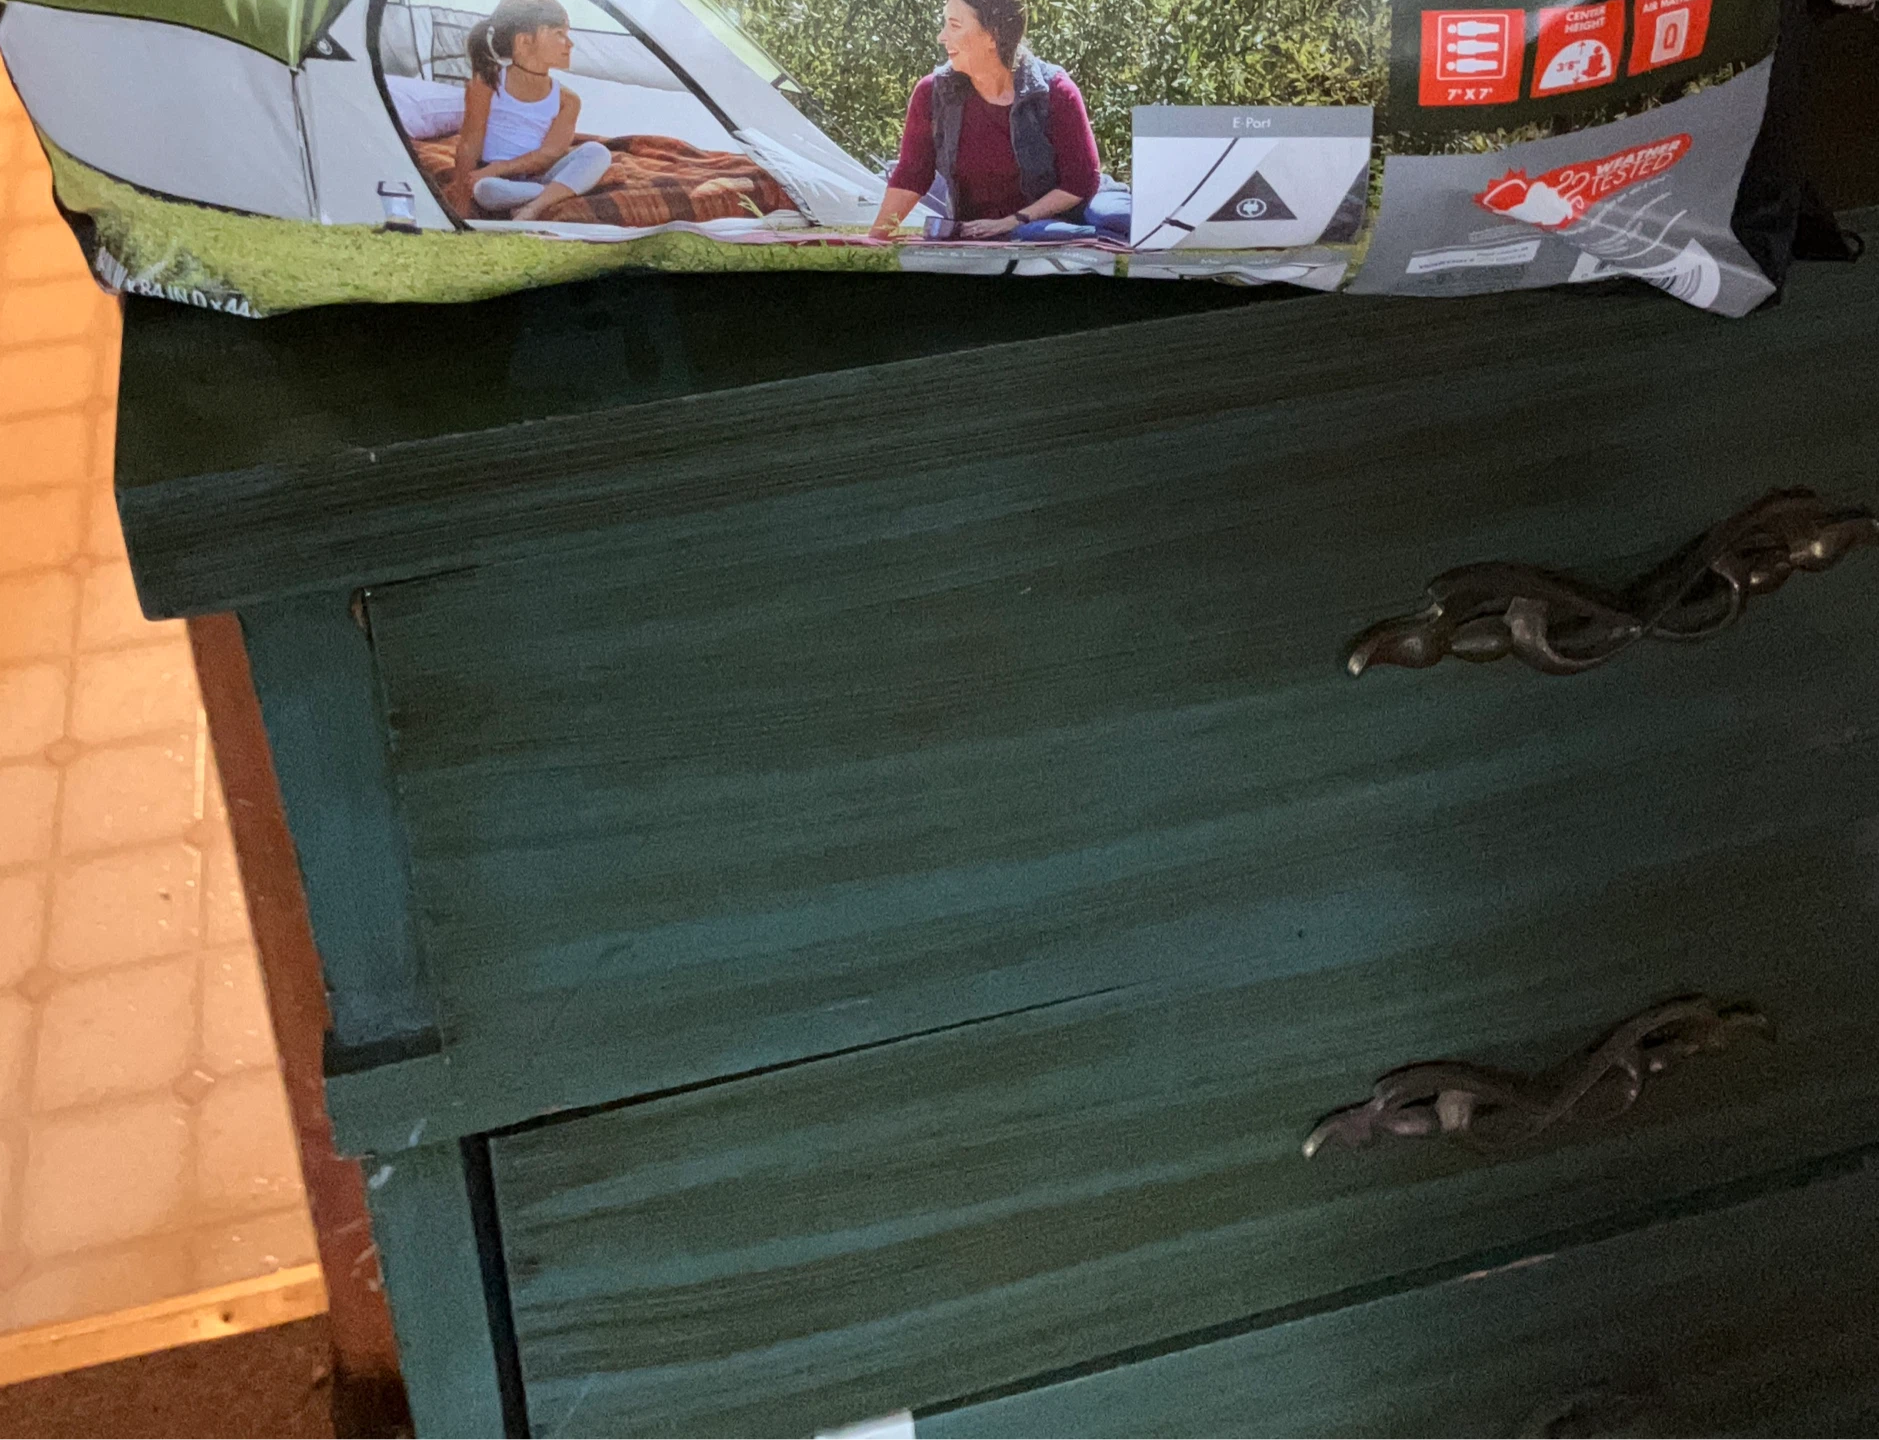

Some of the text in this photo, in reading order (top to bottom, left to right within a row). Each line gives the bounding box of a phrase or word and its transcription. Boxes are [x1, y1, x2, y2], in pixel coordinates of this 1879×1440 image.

[1564, 16, 1607, 34] HEIGHT
[1565, 6, 1607, 23] CENTER
[1595, 139, 1682, 177] WEATHER
[1591, 152, 1673, 196] TESTED
